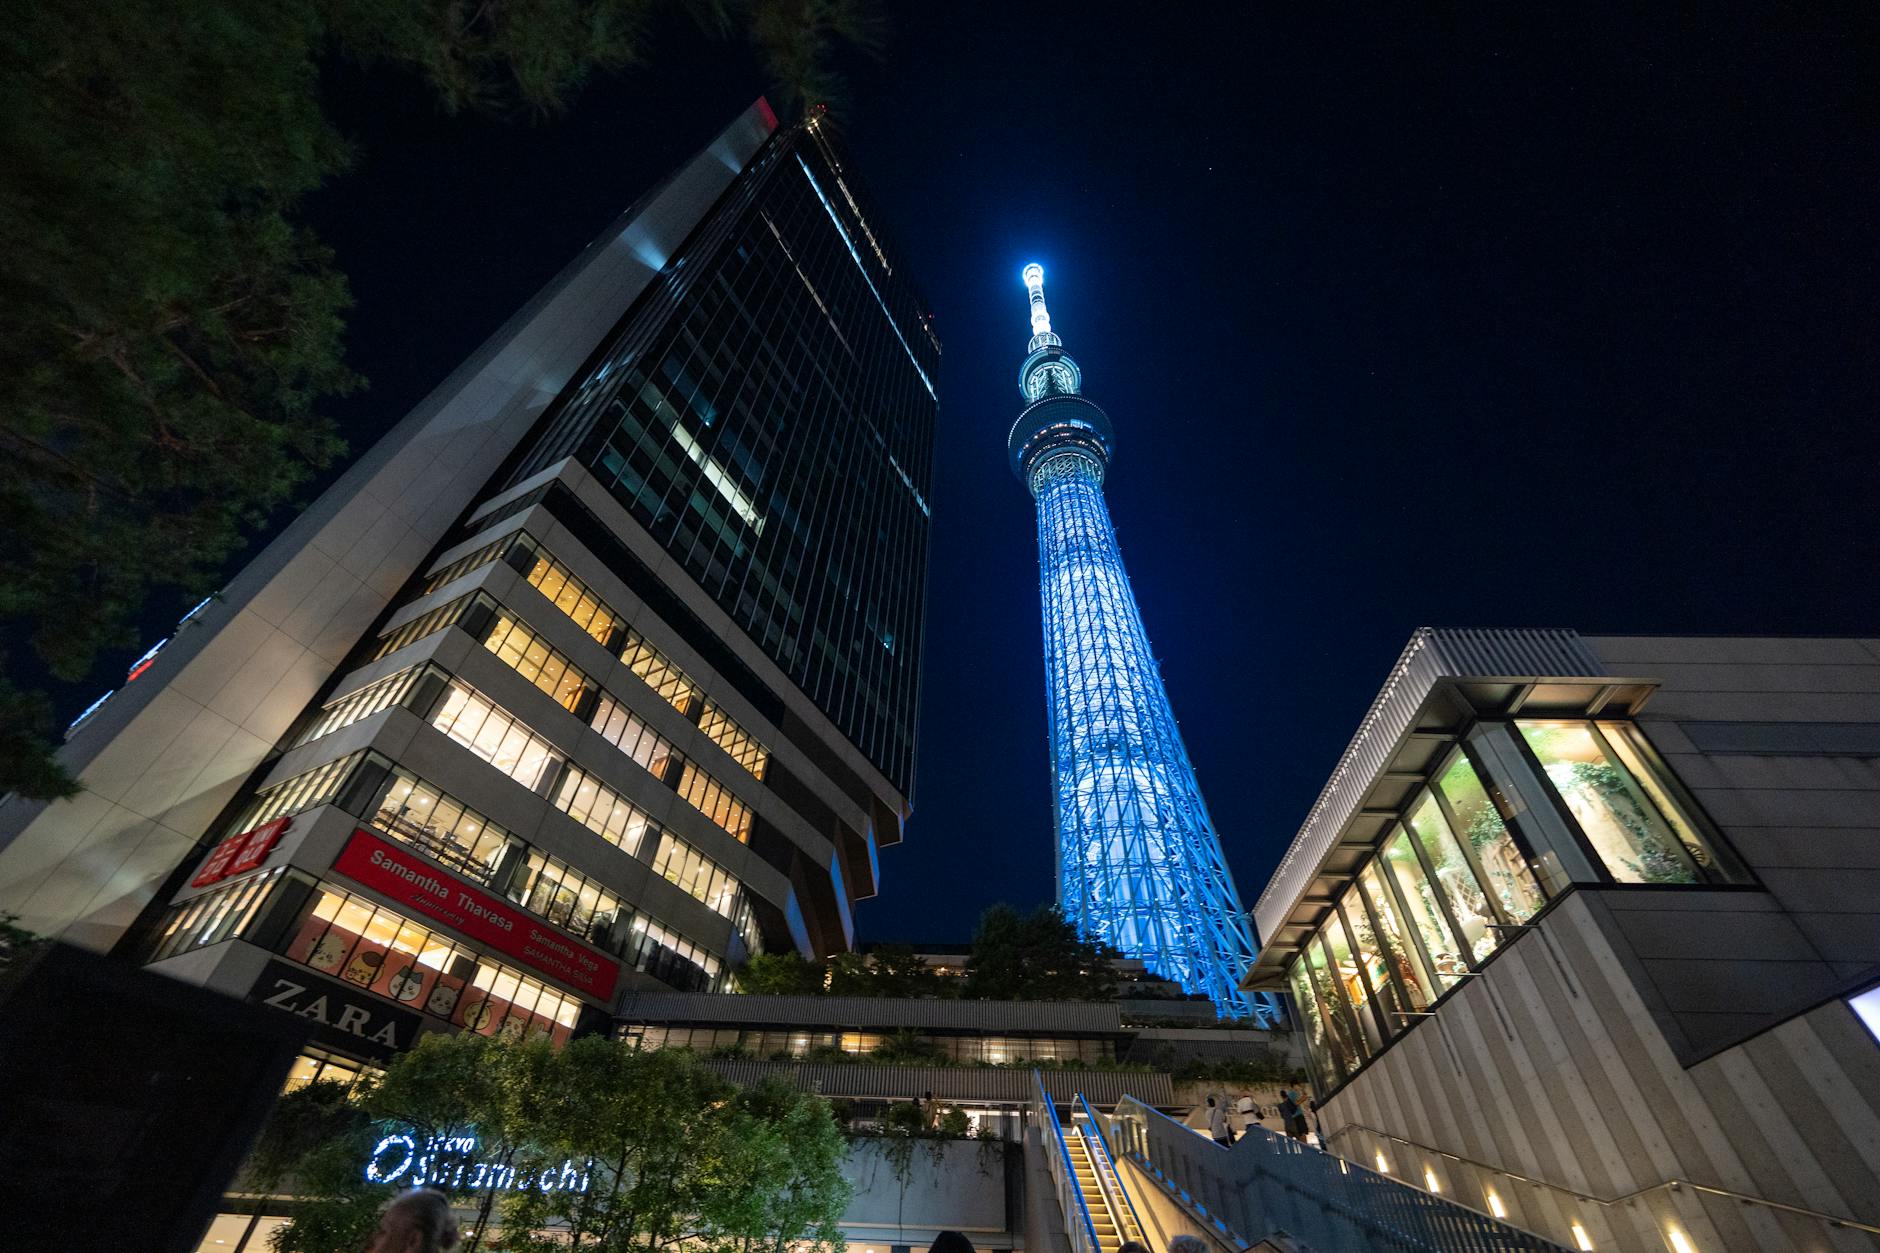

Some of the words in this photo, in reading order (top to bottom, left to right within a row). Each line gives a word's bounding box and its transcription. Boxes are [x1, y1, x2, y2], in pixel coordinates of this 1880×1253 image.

[370, 849, 450, 898] Samantha
[457, 892, 514, 932] Thavasa
[529, 928, 575, 959] Samantha
[578, 953, 600, 972] Vega
[263, 978, 399, 1050] ZARA
